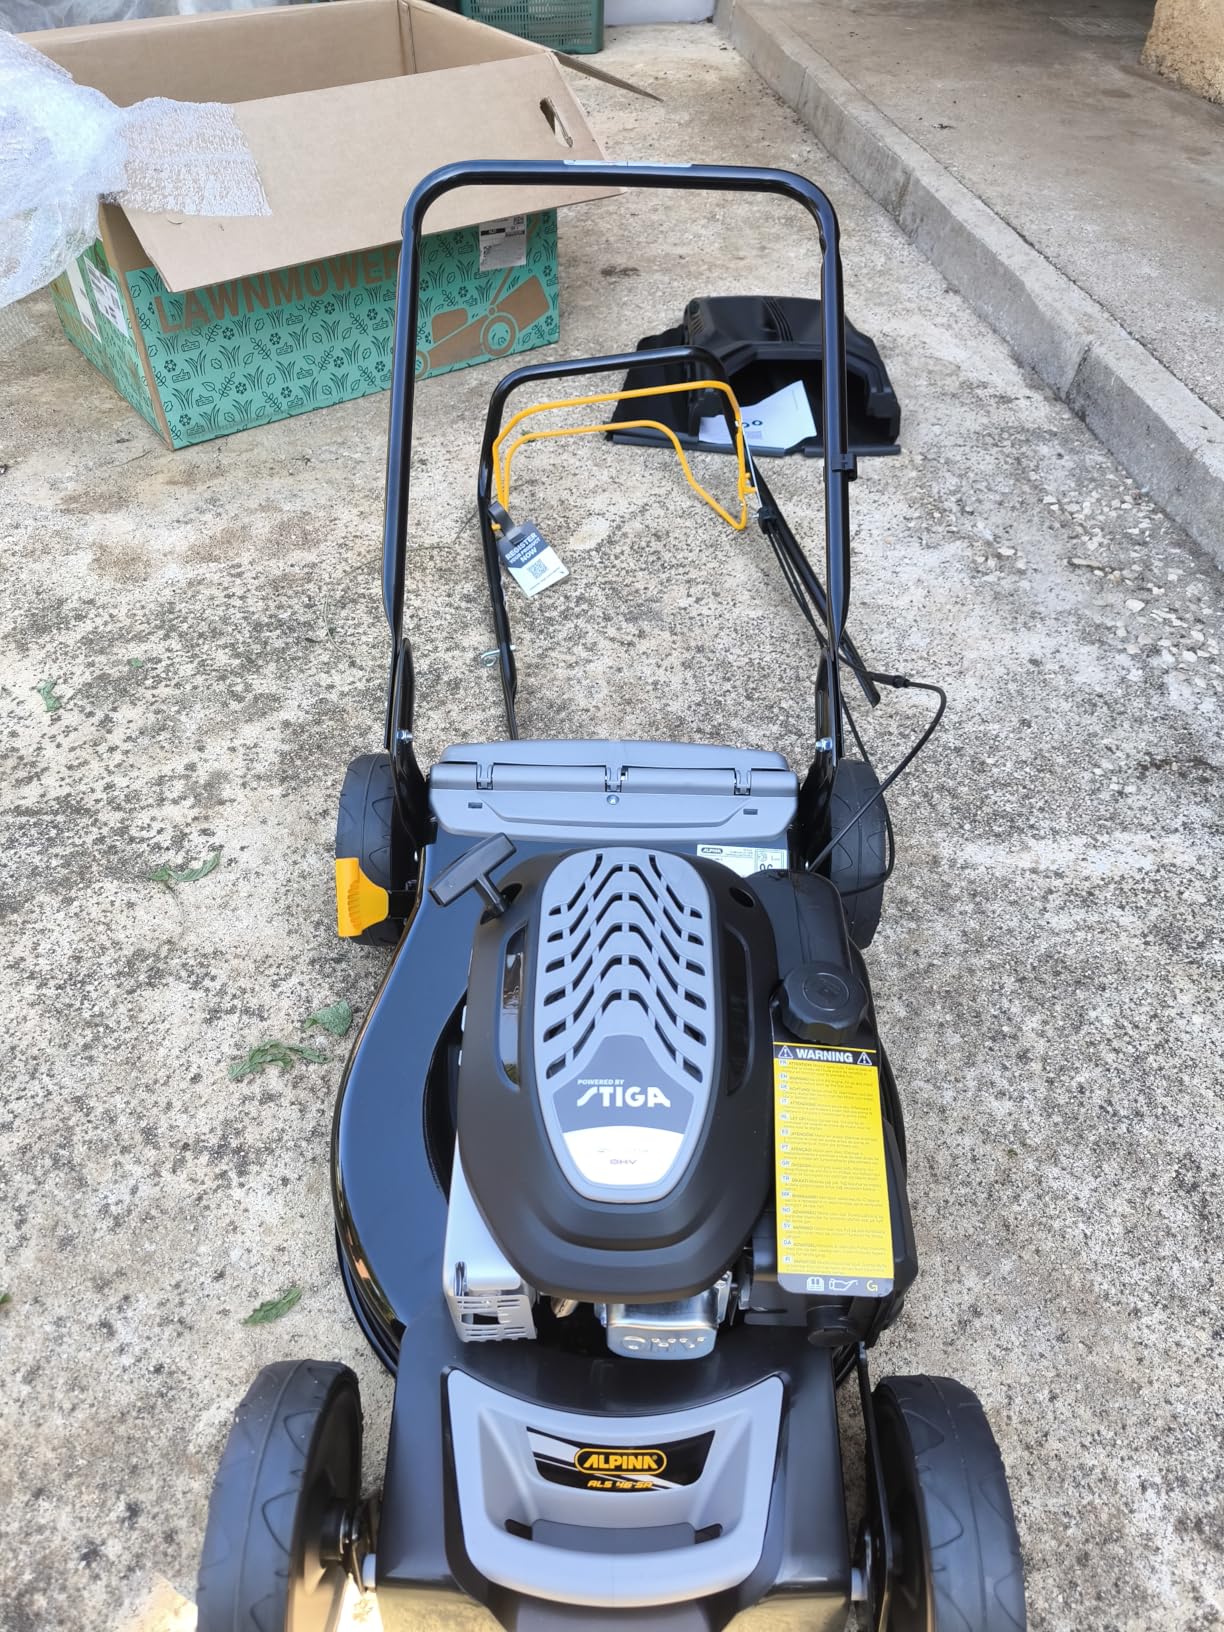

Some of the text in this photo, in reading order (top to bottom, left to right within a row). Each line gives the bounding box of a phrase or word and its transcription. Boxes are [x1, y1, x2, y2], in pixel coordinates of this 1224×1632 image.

[505, 532, 538, 561] REGISTER
[520, 547, 537, 562] NOW
[795, 1049, 853, 1063] WARNING
[577, 1086, 671, 1107] STIGA
[583, 1454, 658, 1470] ALPINA
